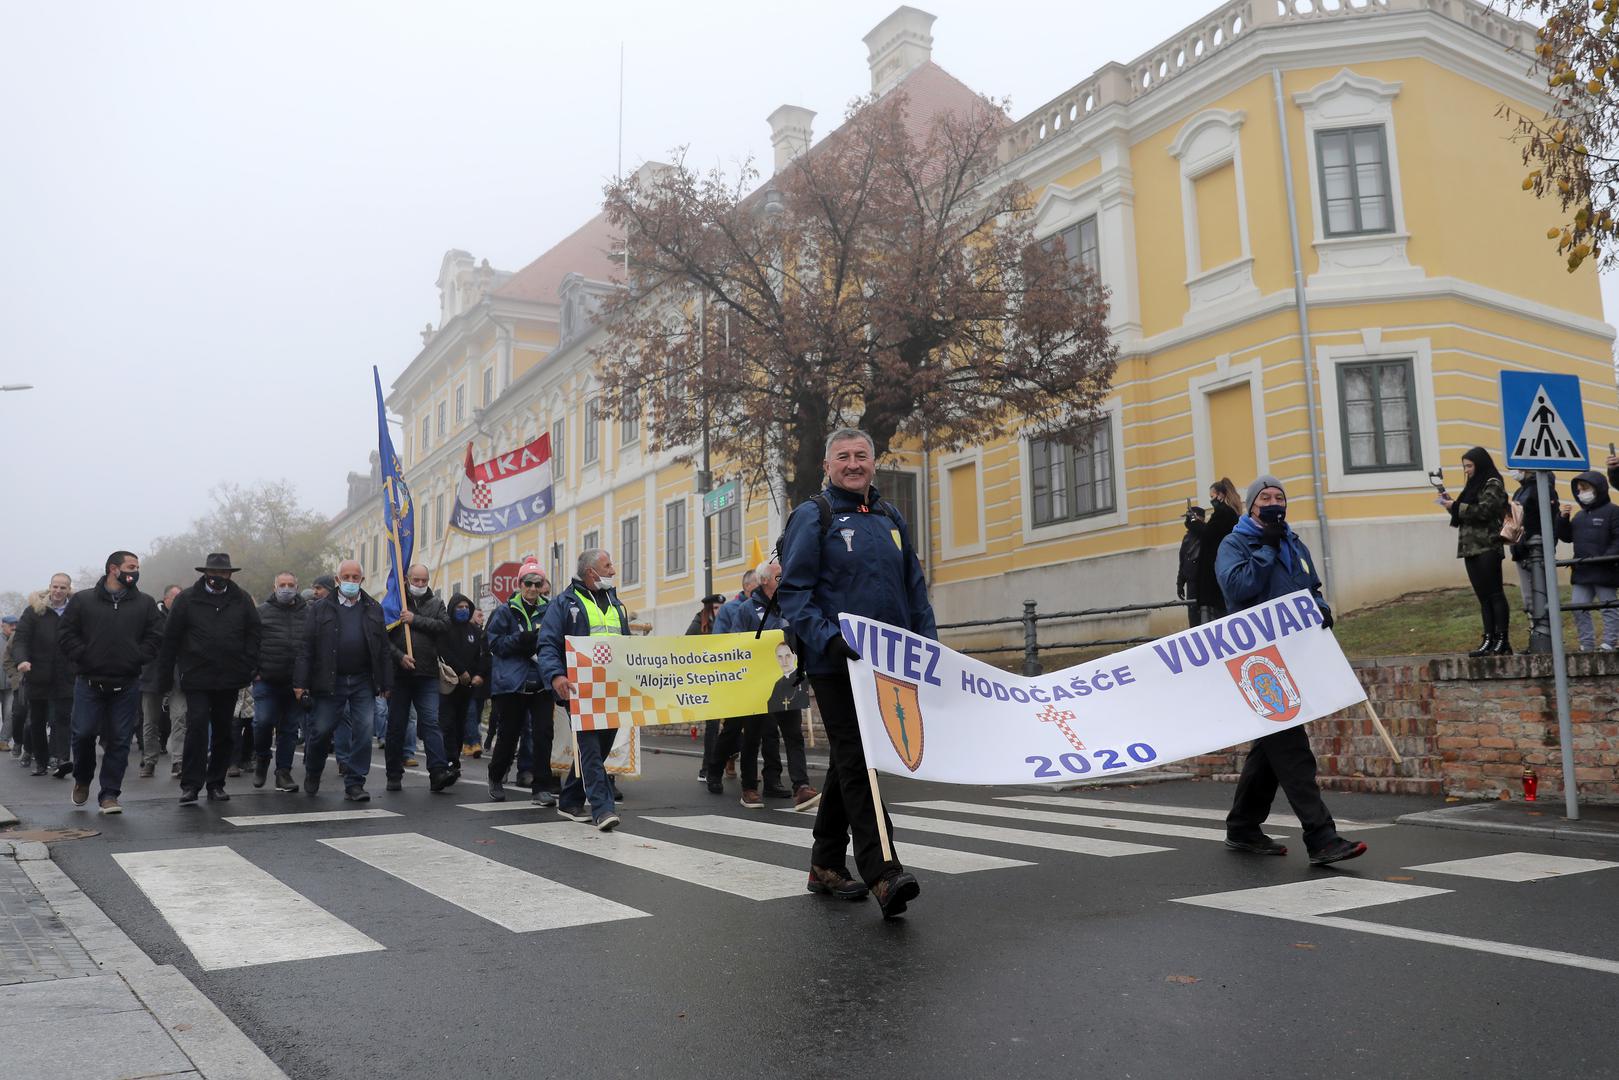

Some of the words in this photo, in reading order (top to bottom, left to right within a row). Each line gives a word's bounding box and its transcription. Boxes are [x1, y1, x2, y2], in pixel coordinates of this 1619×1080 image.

[484, 448, 540, 480] IKA
[494, 576, 519, 592] STO
[626, 653, 668, 669] Udruga
[670, 649, 752, 665] hodočasnika
[841, 618, 941, 687] VITEZ
[961, 665, 1136, 703] HODOČAŠĆE
[1152, 595, 1324, 675] VUKOVAR
[635, 674, 684, 689] "Alojzije
[686, 668, 747, 686] Stepinac"
[676, 693, 709, 706] Vitez
[1024, 742, 1157, 778] 2020
